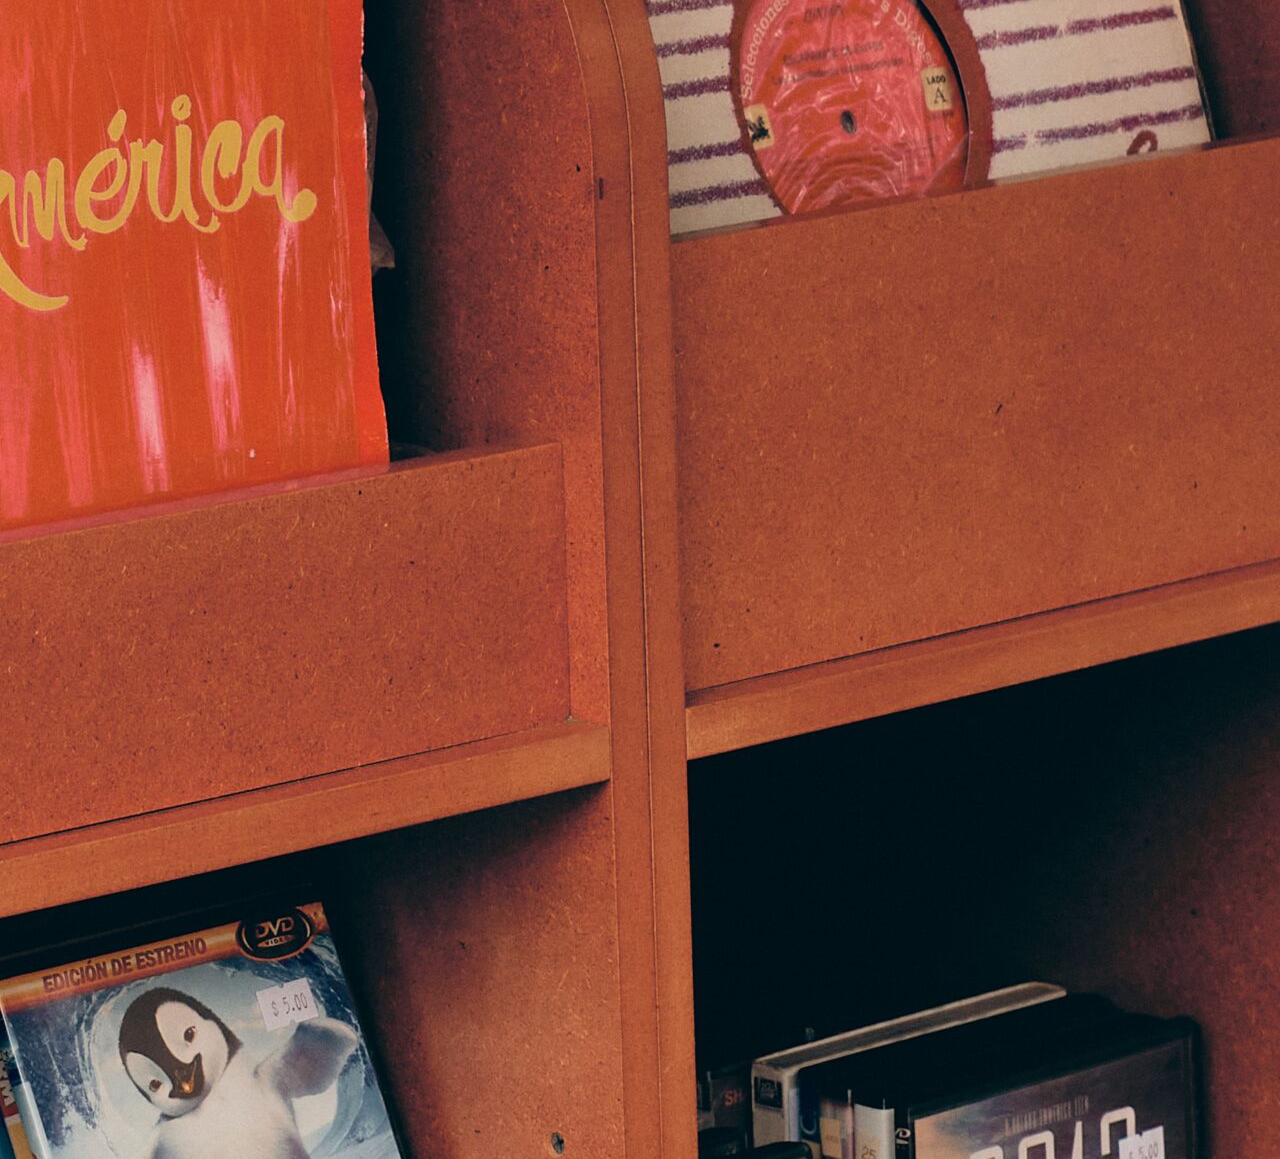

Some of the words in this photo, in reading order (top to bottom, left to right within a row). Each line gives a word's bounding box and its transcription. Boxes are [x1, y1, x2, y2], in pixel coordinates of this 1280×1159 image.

[893, 7, 934, 66] Diges
[926, 74, 946, 85] LADO
[933, 86, 947, 104] A
[255, 915, 296, 940] DVD
[42, 960, 108, 993] EDICIÓN
[111, 953, 134, 976] DE
[136, 937, 208, 971] ESTRENO
[281, 992, 309, 1013] 5.00
